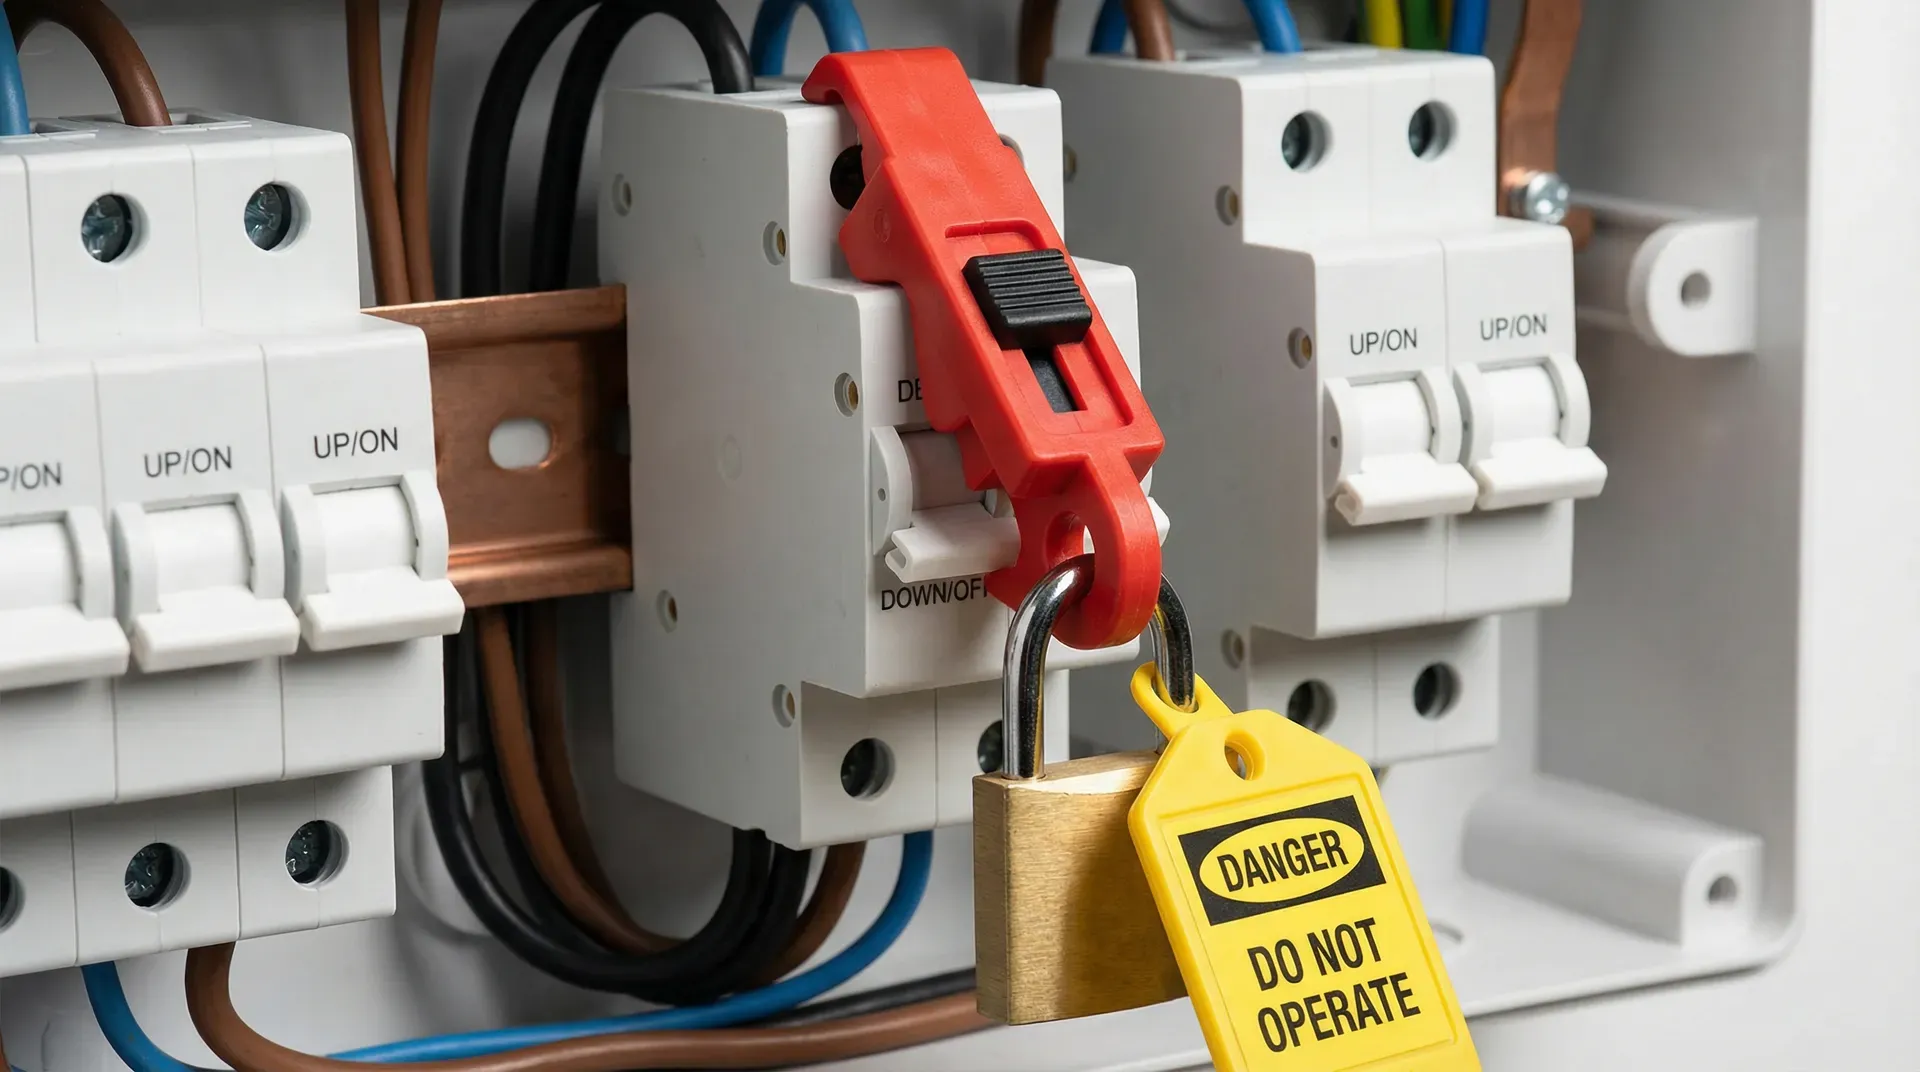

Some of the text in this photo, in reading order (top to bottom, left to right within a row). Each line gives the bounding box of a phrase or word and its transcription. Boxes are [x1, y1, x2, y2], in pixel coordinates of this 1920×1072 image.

[1350, 328, 1417, 356] UP/ON
[1481, 315, 1548, 342] UP/ON
[313, 426, 399, 459] UP/ON
[144, 446, 233, 479] UP/ON
[881, 577, 988, 611] DOWN/OF
[1216, 829, 1350, 893] DANGER
[1246, 917, 1383, 992] DO NOT
[1257, 972, 1421, 1053] OPERATE
